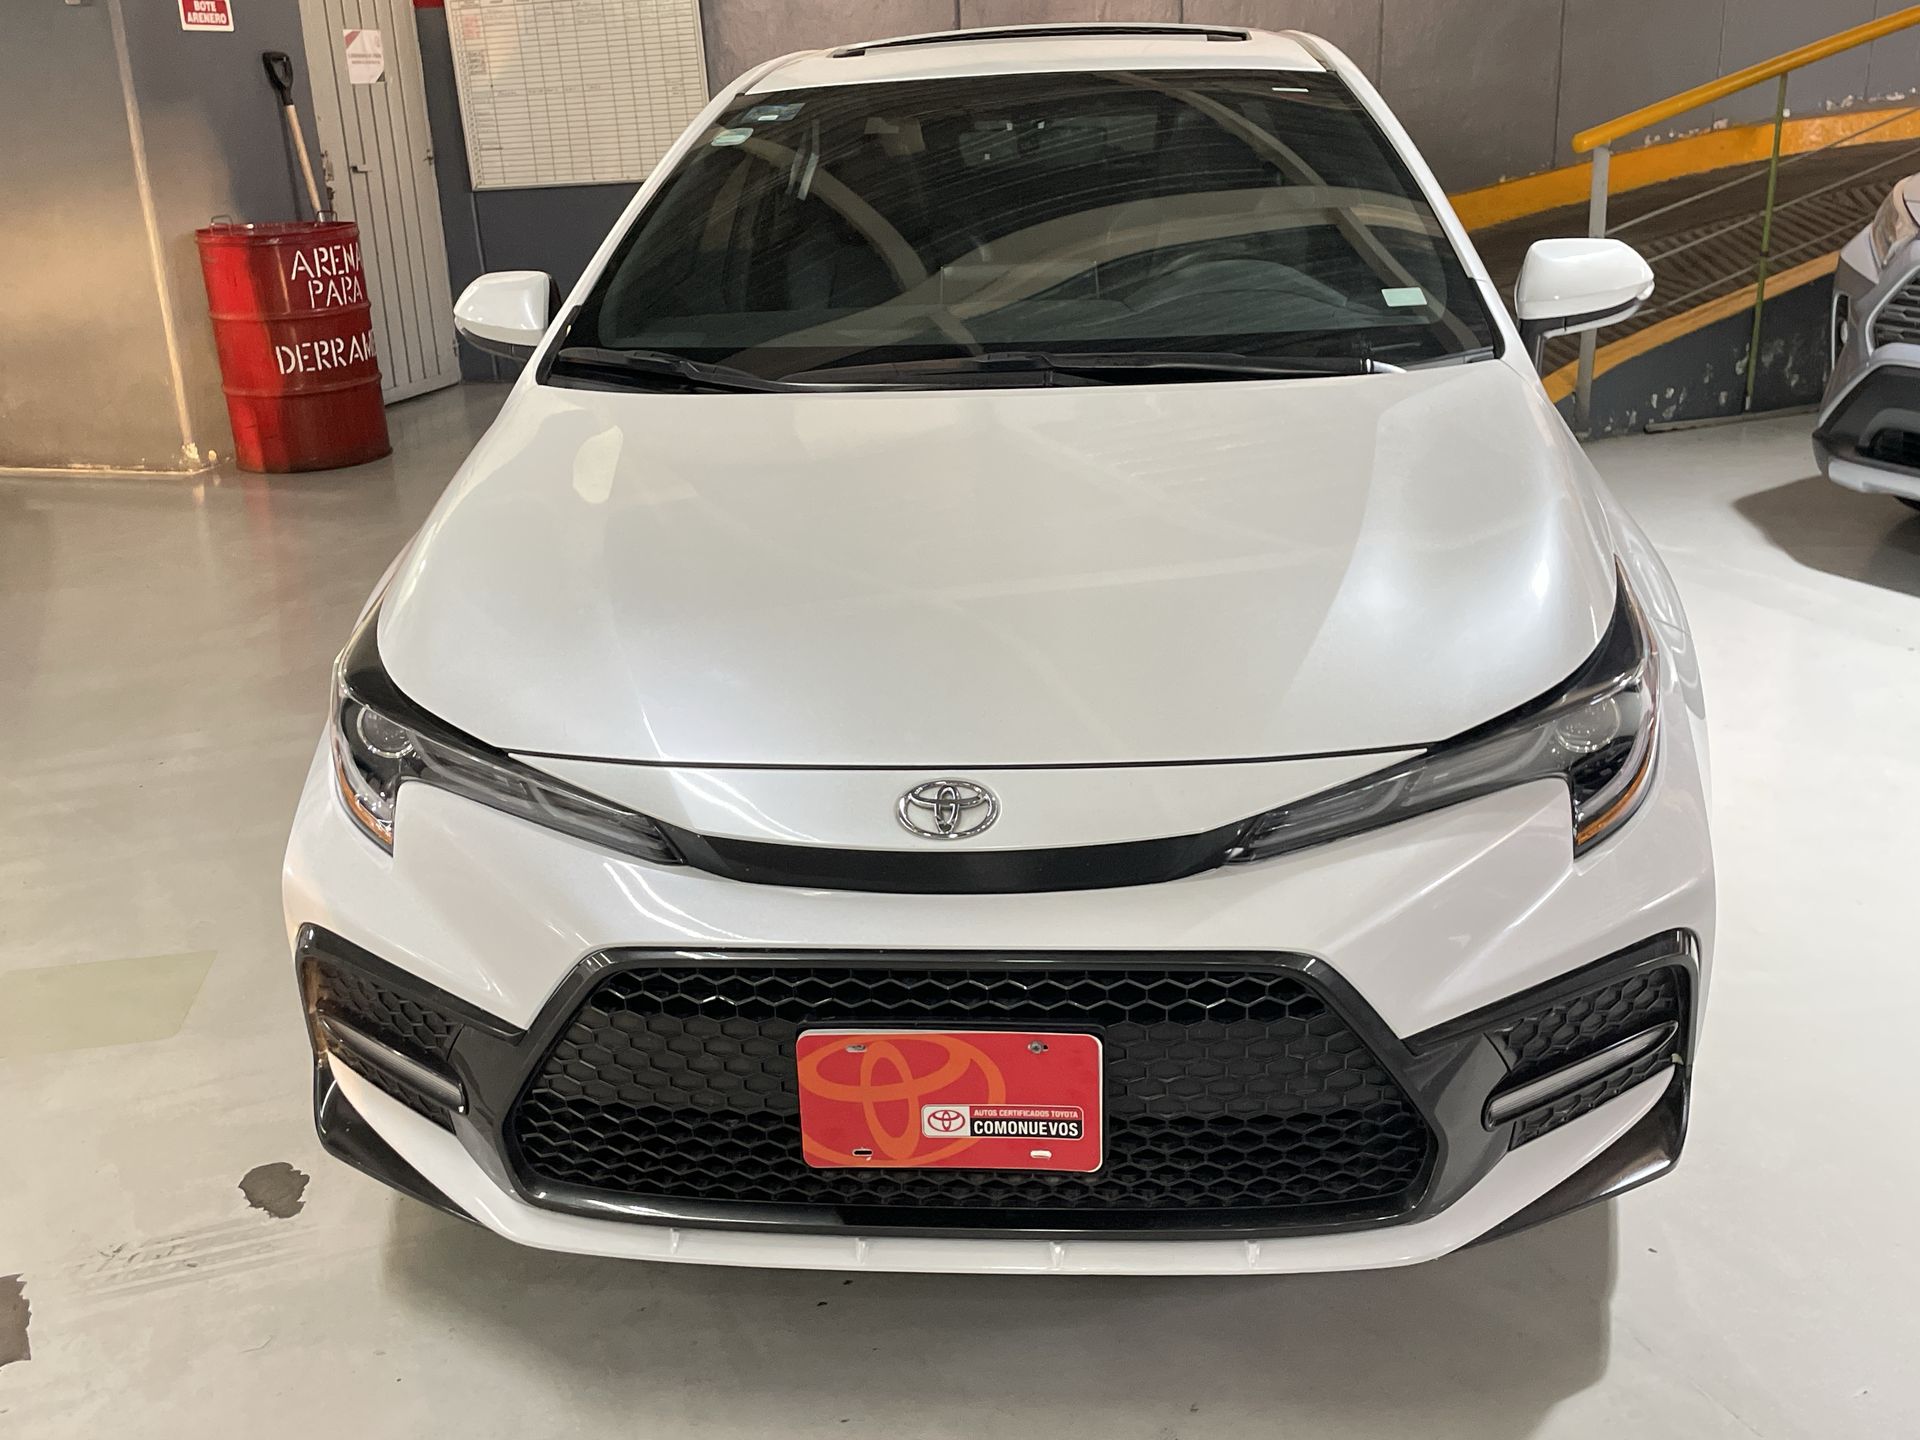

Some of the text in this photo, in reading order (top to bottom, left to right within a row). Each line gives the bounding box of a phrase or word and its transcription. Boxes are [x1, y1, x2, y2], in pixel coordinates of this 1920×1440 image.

[193, 0, 217, 12] BOTE
[187, 11, 227, 25] ARENERO
[291, 242, 362, 280] ARENA
[308, 275, 363, 309] PARA
[974, 1109, 1078, 1118] AUTOS CERTIFICADOS TOYOTA
[974, 1120, 1078, 1136] COMONUEVOS
